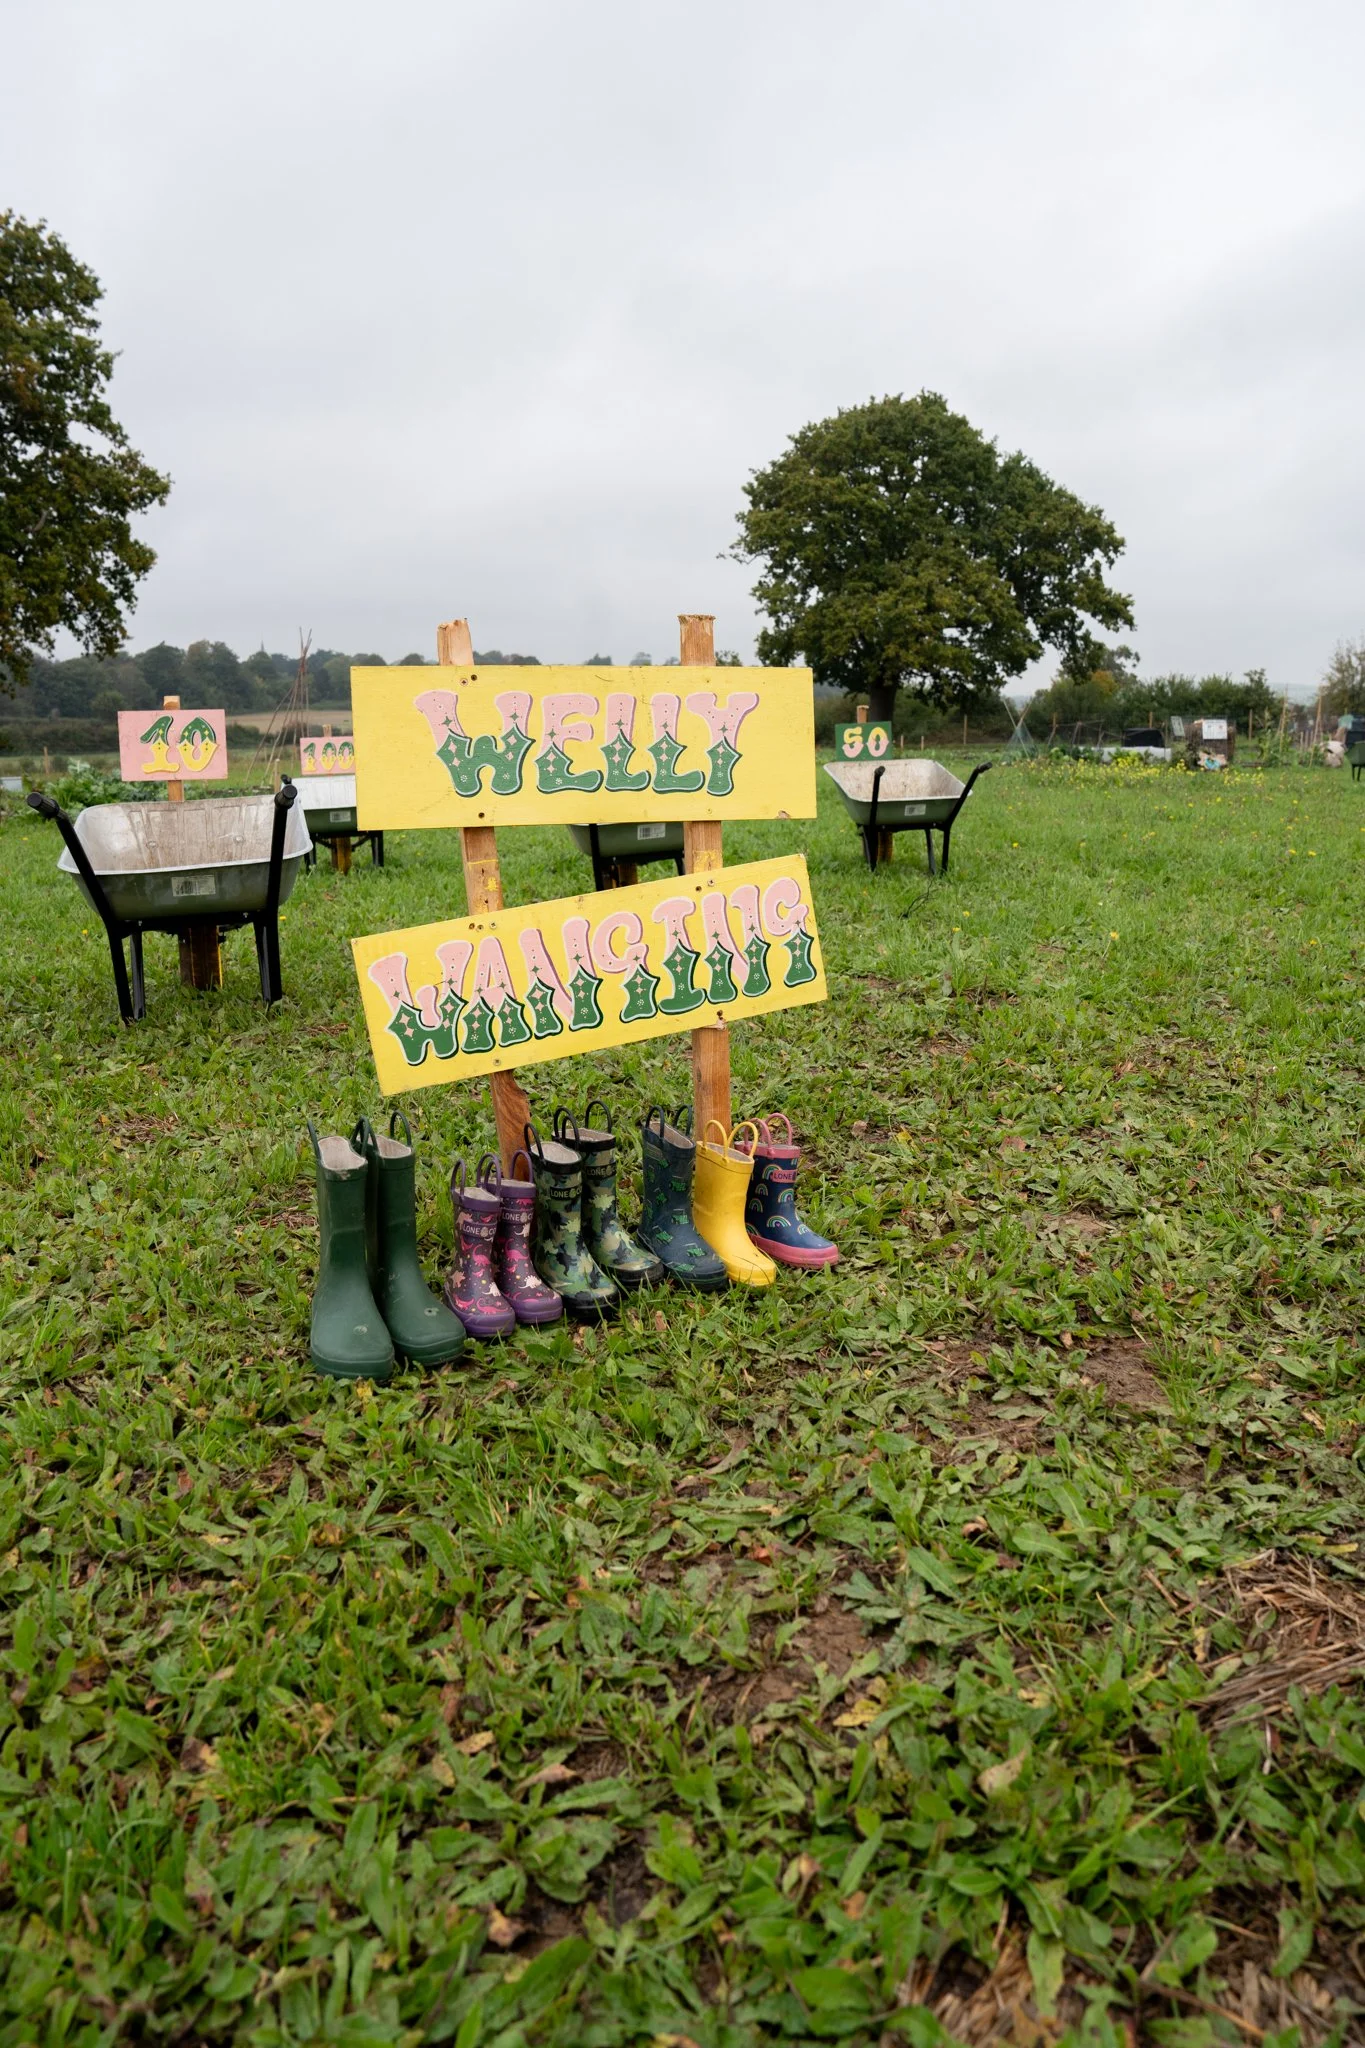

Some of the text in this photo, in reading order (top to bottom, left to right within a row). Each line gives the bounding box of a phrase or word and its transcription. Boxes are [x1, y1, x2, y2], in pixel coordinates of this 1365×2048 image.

[139, 714, 219, 774] 10
[303, 741, 355, 772] 100
[414, 690, 759, 797] WELLY
[842, 726, 889, 758] 50
[368, 877, 817, 1065] WANGING
[774, 1172, 792, 1180] LONE
[550, 1189, 569, 1198] LONE
[463, 1223, 480, 1236] LONE
[502, 1211, 520, 1222] LONE
